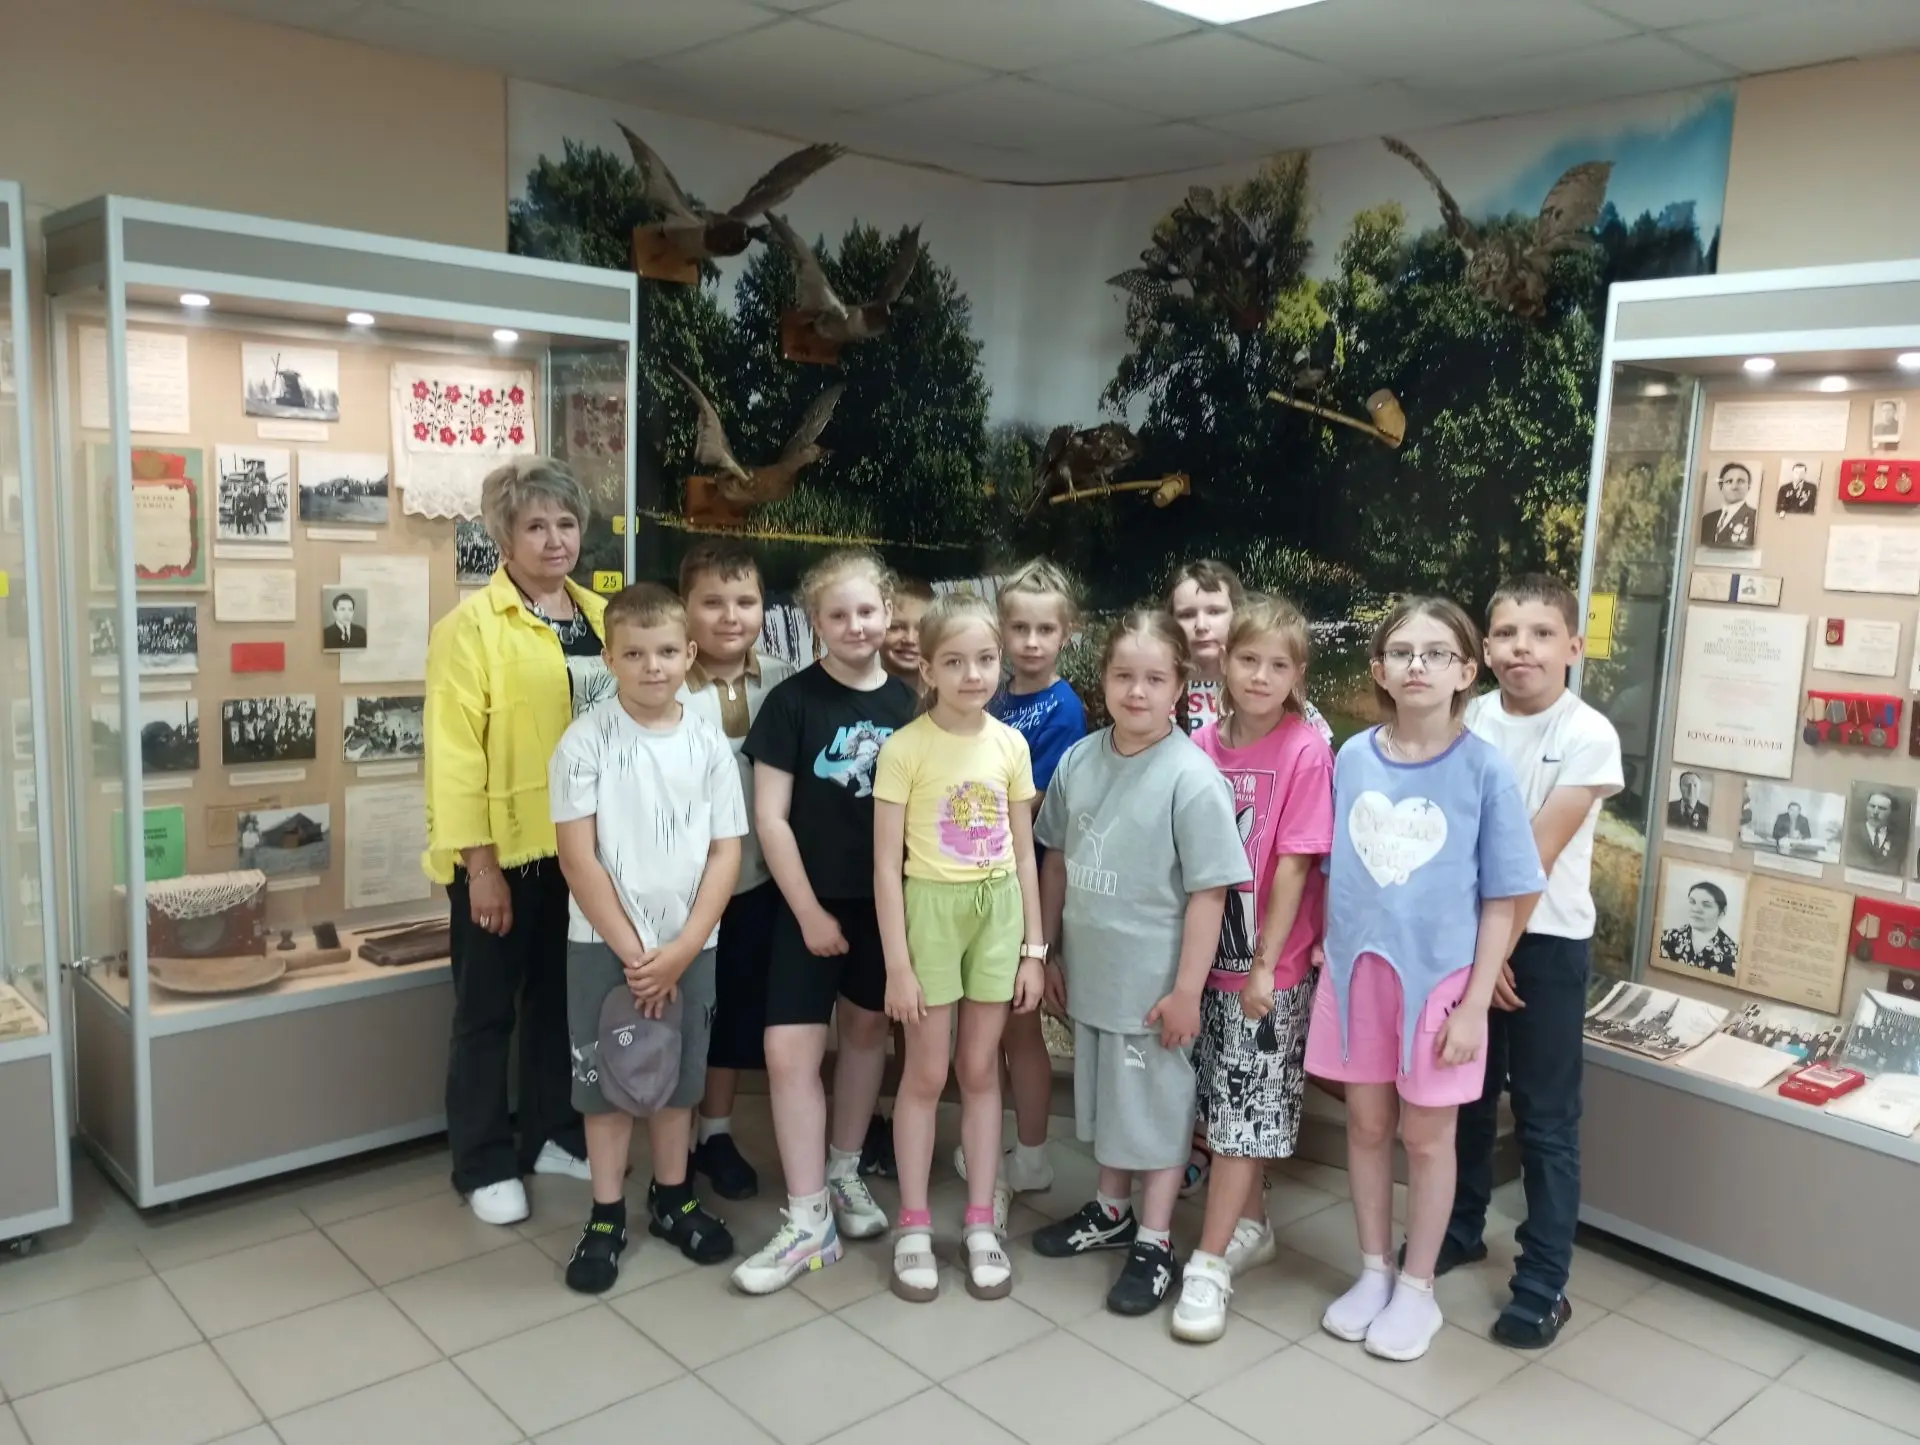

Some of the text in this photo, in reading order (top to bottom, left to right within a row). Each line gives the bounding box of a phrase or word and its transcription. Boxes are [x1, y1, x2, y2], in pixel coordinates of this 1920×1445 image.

[602, 575, 617, 588] 25
[1687, 729, 1783, 751] КРАСНОЕ ЗНАМЯ
